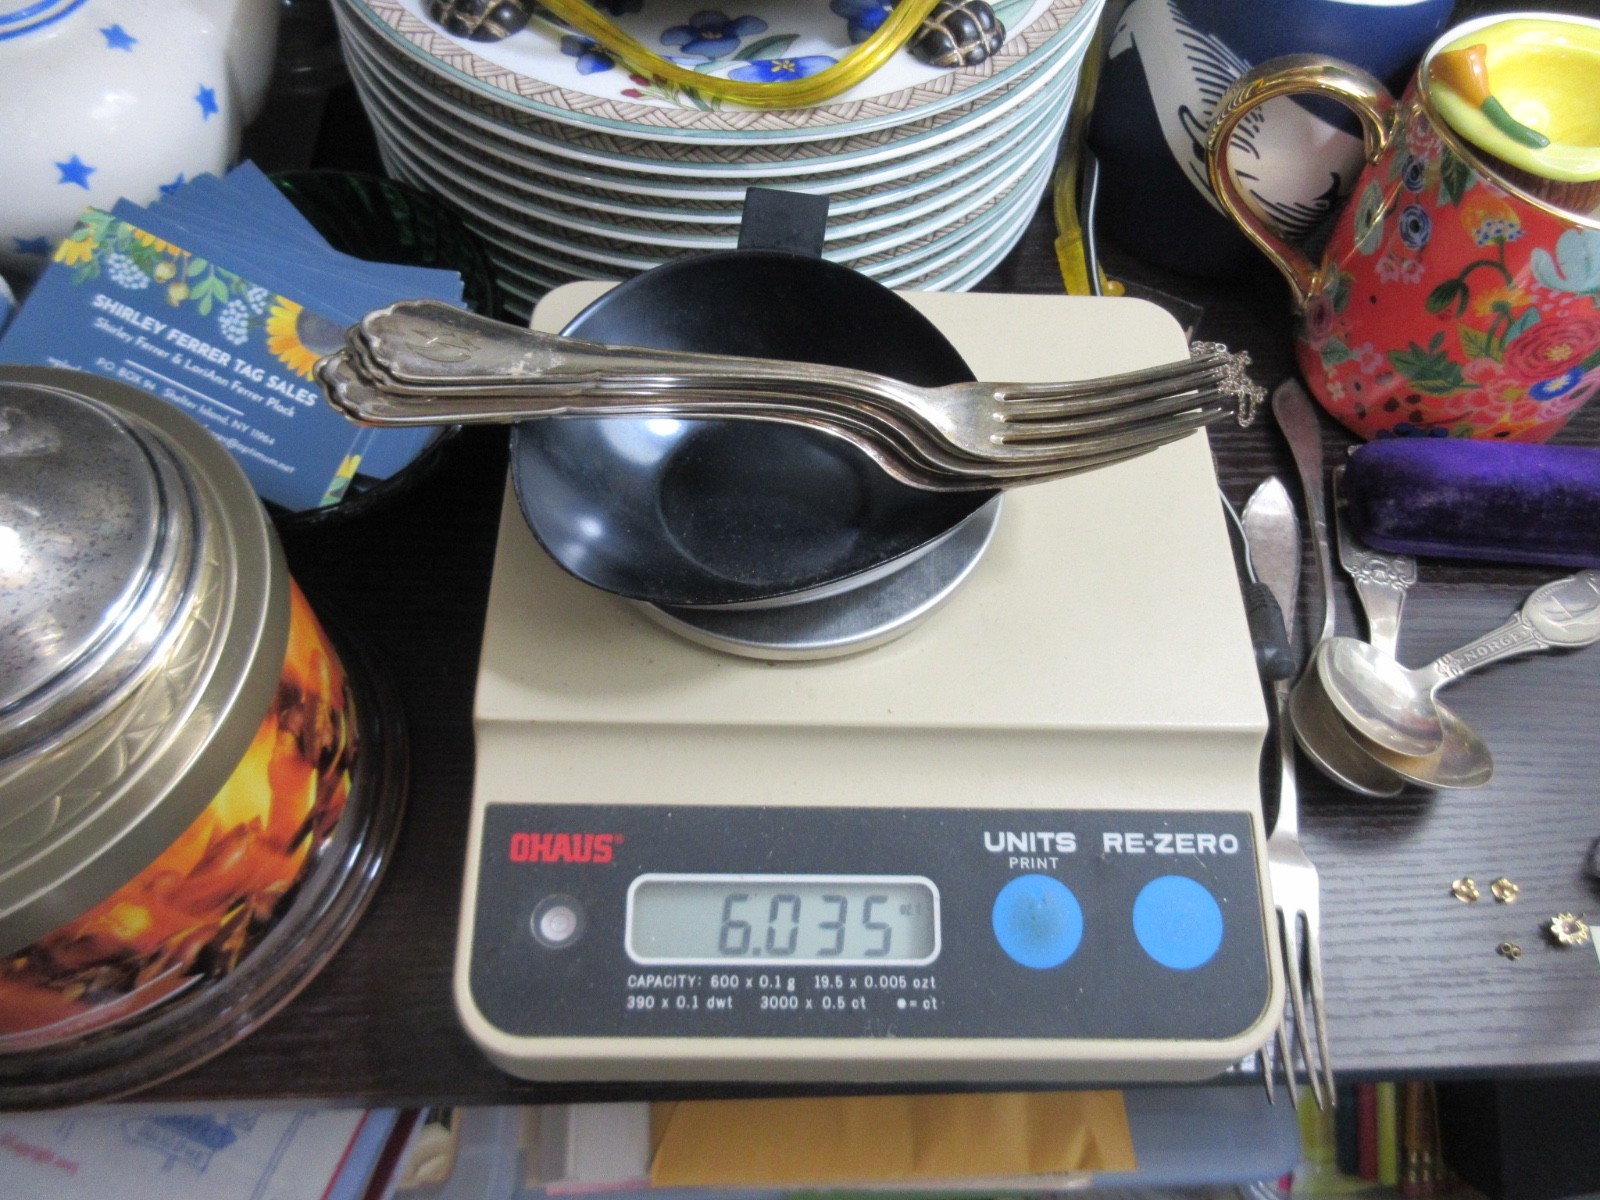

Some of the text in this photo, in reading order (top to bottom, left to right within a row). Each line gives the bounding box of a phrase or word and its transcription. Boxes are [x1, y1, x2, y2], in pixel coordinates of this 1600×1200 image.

[92, 293, 318, 407] SHIRLEY FERRER TAG SALES
[94, 316, 135, 343] Shirley
[135, 335, 170, 359] Ferrer
[172, 353, 183, 365] &
[230, 381, 264, 403] Ferrer
[265, 397, 295, 417] Plock
[231, 419, 250, 433] NY
[984, 831, 1077, 854] UNITS
[1103, 832, 1239, 854] RE-ZERO
[1009, 857, 1059, 870] PRINT
[718, 893, 893, 957] 6.035
[627, 974, 936, 992] CAPACITY: 600 x 0.1 g 19.5 x 0.005 ozt
[627, 995, 655, 1010] 390
[661, 998, 669, 1009] x
[676, 996, 698, 1010] 0.1
[706, 995, 733, 1010] dwt
[760, 995, 798, 1010] 3000
[805, 998, 813, 1010] x
[822, 996, 845, 1010] 0.5
